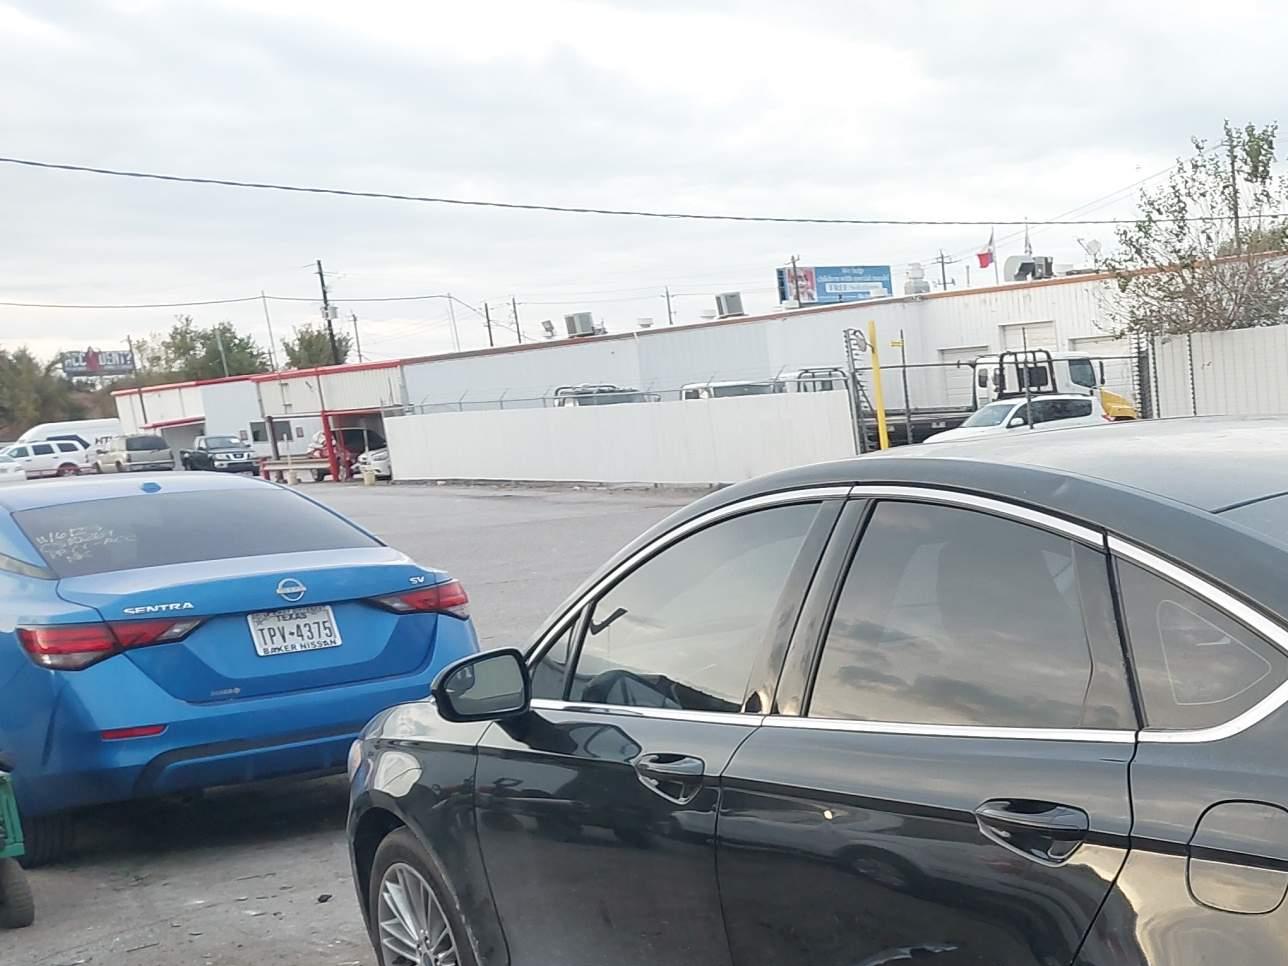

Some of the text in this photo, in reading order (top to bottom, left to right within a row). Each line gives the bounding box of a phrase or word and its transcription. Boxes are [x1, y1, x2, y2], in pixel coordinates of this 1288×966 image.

[410, 576, 425, 584] SV
[123, 602, 195, 615] SENTRA
[276, 612, 307, 621] TEXAS
[263, 640, 337, 655] BAKER NISSAN
